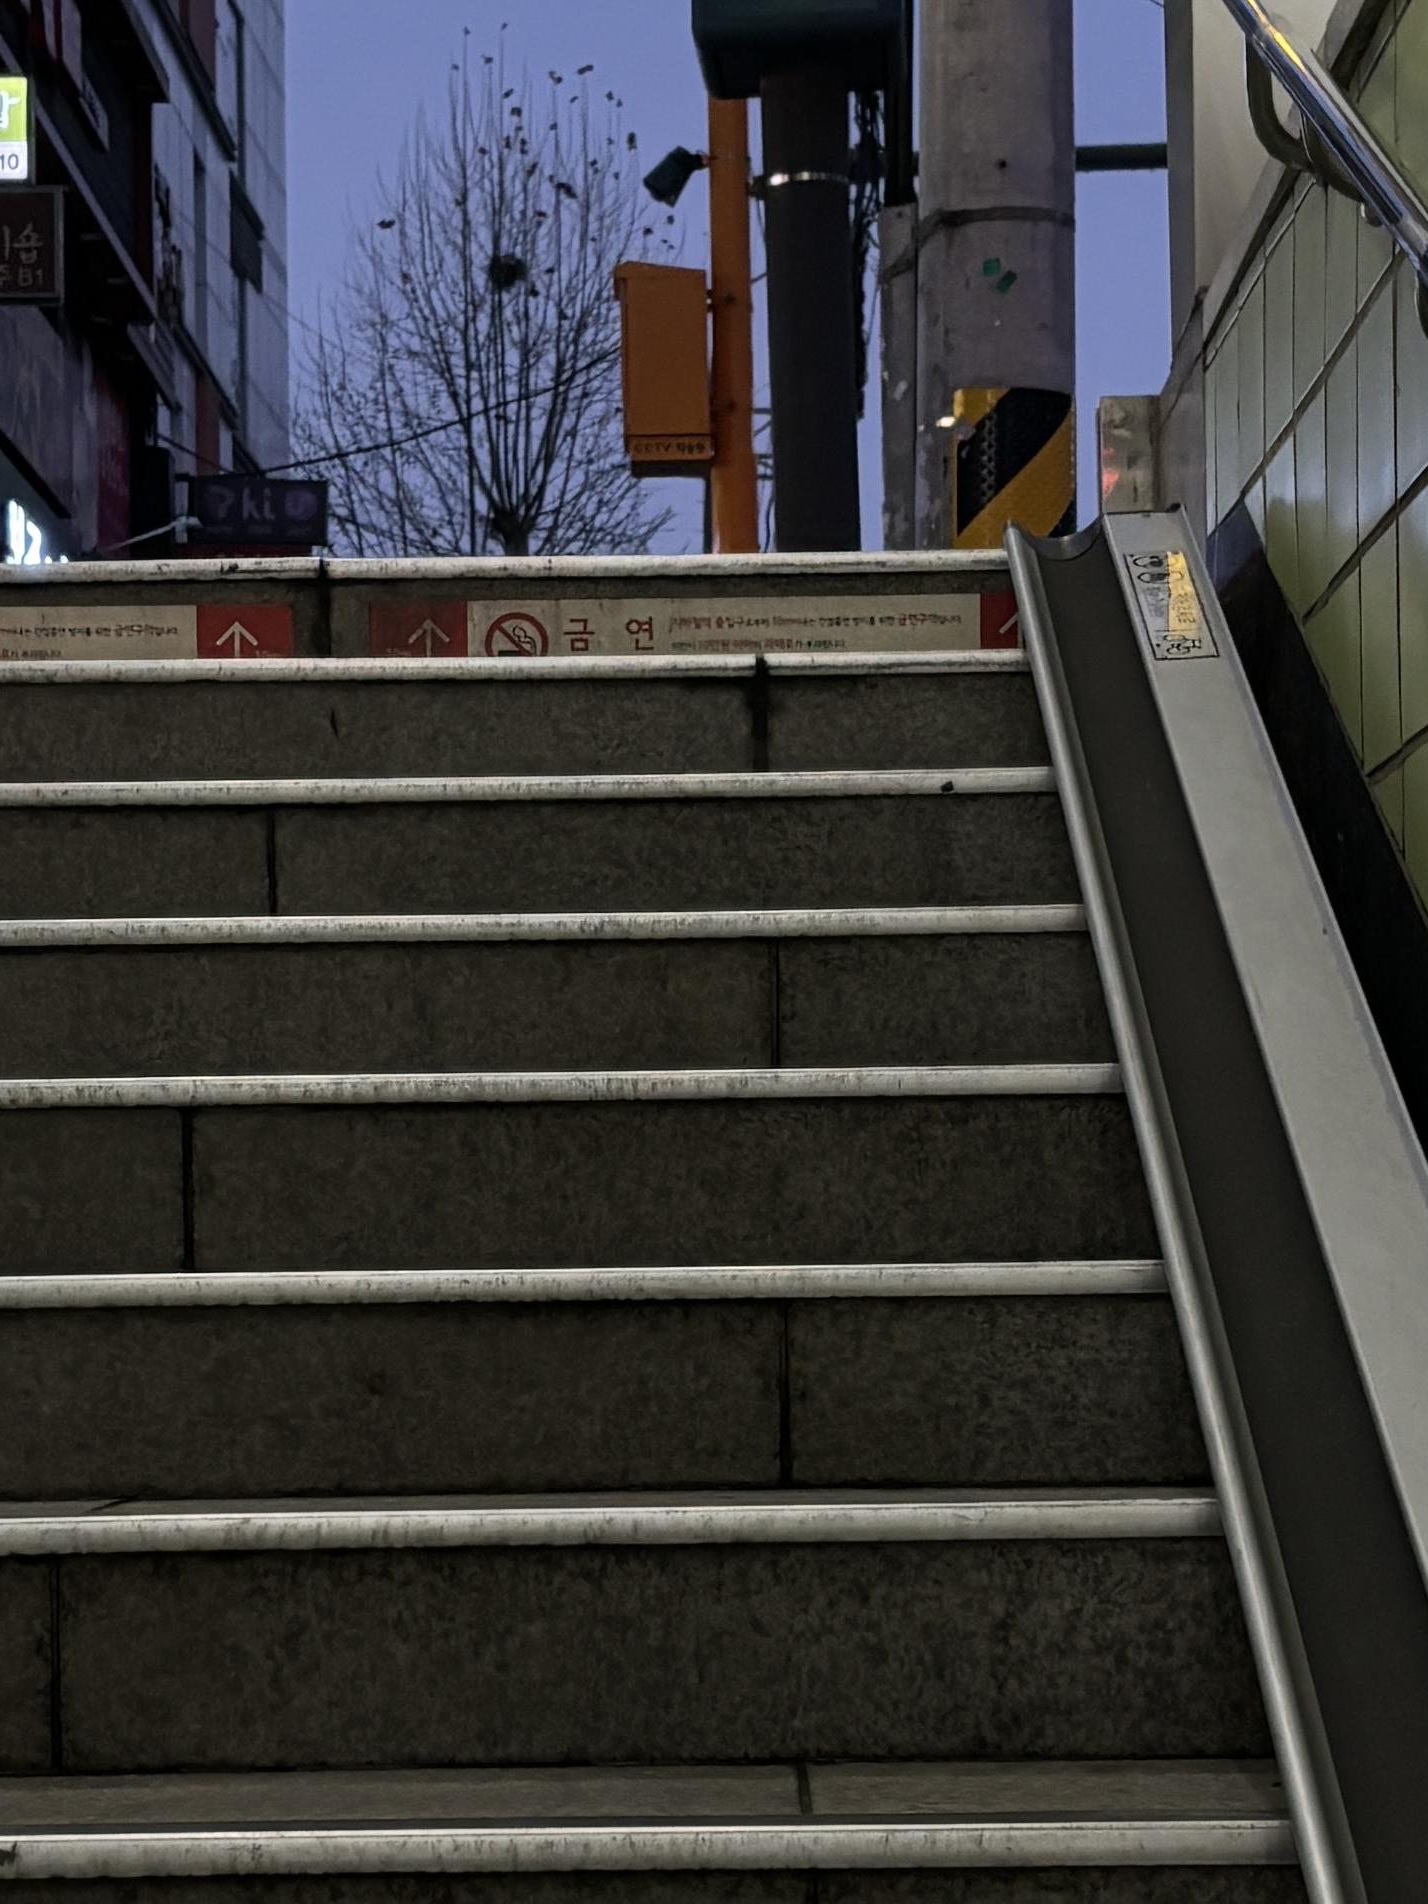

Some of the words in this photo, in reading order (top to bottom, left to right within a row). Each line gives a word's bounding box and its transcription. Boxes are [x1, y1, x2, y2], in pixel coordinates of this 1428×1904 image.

[18, 268, 44, 287] B1
[564, 618, 595, 652] 금
[626, 616, 654, 652] 연
